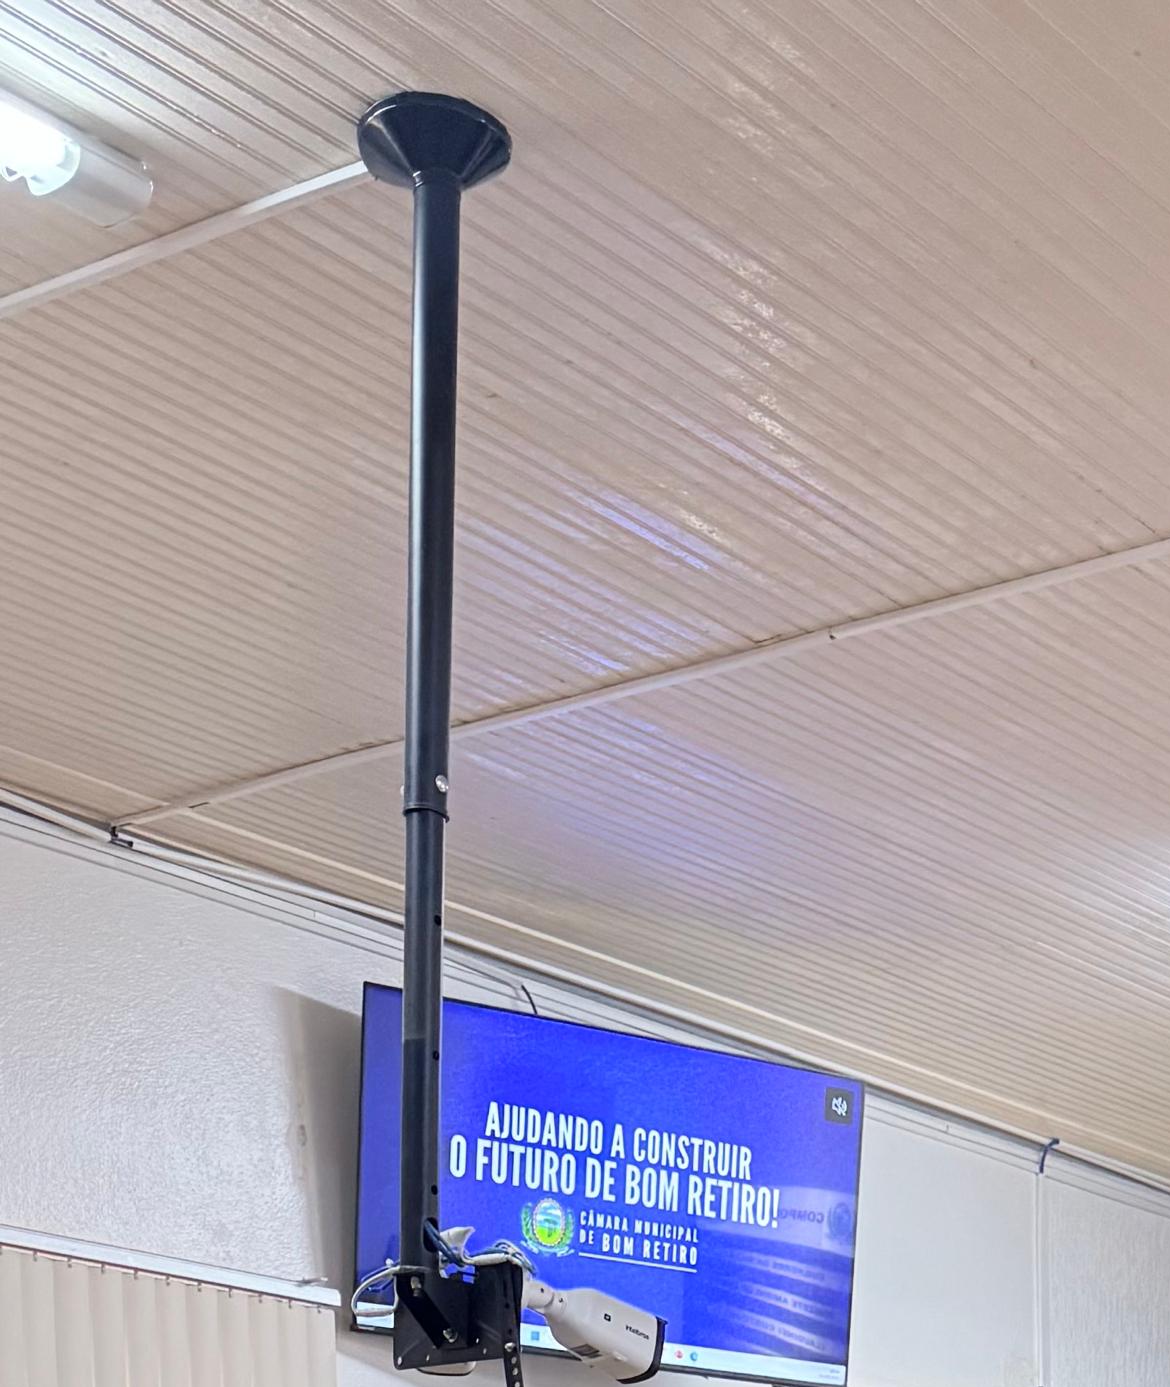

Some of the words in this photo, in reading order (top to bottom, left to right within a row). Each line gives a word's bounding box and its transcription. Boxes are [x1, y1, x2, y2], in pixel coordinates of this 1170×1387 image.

[485, 1101, 604, 1155] AJUDANDO
[611, 1123, 625, 1159] A
[633, 1127, 752, 1180] CONSTRUIR
[449, 1134, 467, 1178] O
[475, 1138, 577, 1195] FUTURO
[585, 1156, 617, 1202] DE
[625, 1163, 679, 1212] BOM
[687, 1174, 780, 1229] RETIRO!
[579, 1228, 594, 1245] DE
[602, 1232, 634, 1256] BOM
[642, 1239, 698, 1266] RETIRO
[580, 1209, 628, 1232] CÂMARA
[634, 1219, 699, 1243] MUNICIPAL
